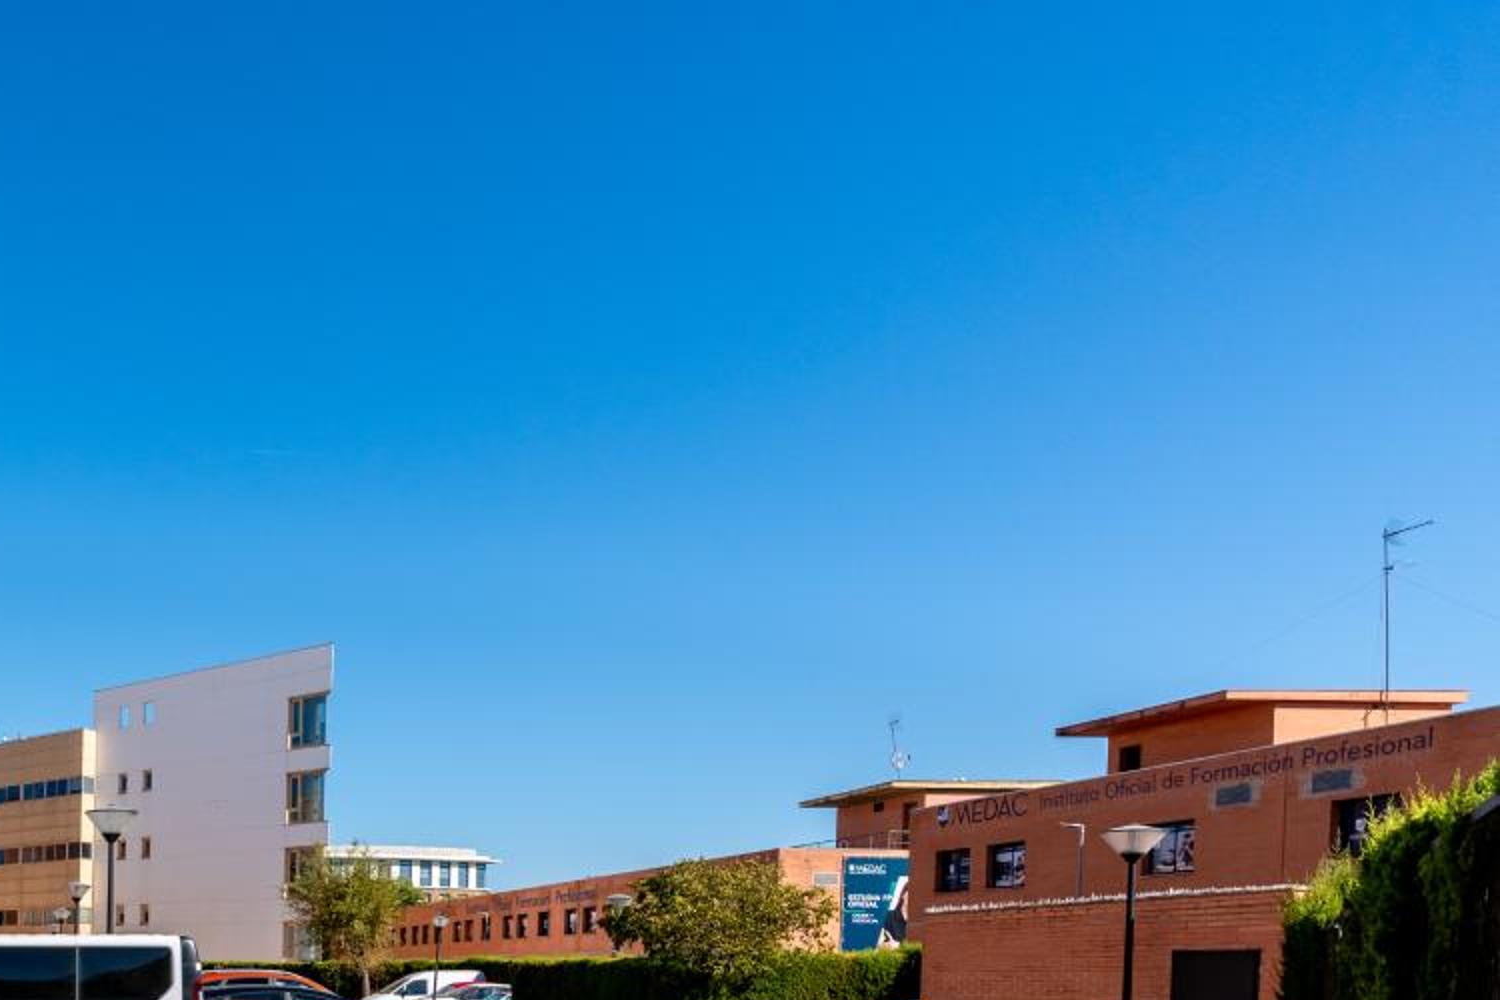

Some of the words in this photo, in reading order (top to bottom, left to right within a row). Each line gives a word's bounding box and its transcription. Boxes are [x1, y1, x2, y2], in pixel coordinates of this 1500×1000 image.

[951, 793, 1028, 825] MEDAC
[1039, 789, 1100, 810] Instituto
[1105, 774, 1157, 801] Oficial
[1162, 771, 1184, 790] de
[1190, 754, 1294, 785] Formación
[1301, 726, 1434, 768] Profesional
